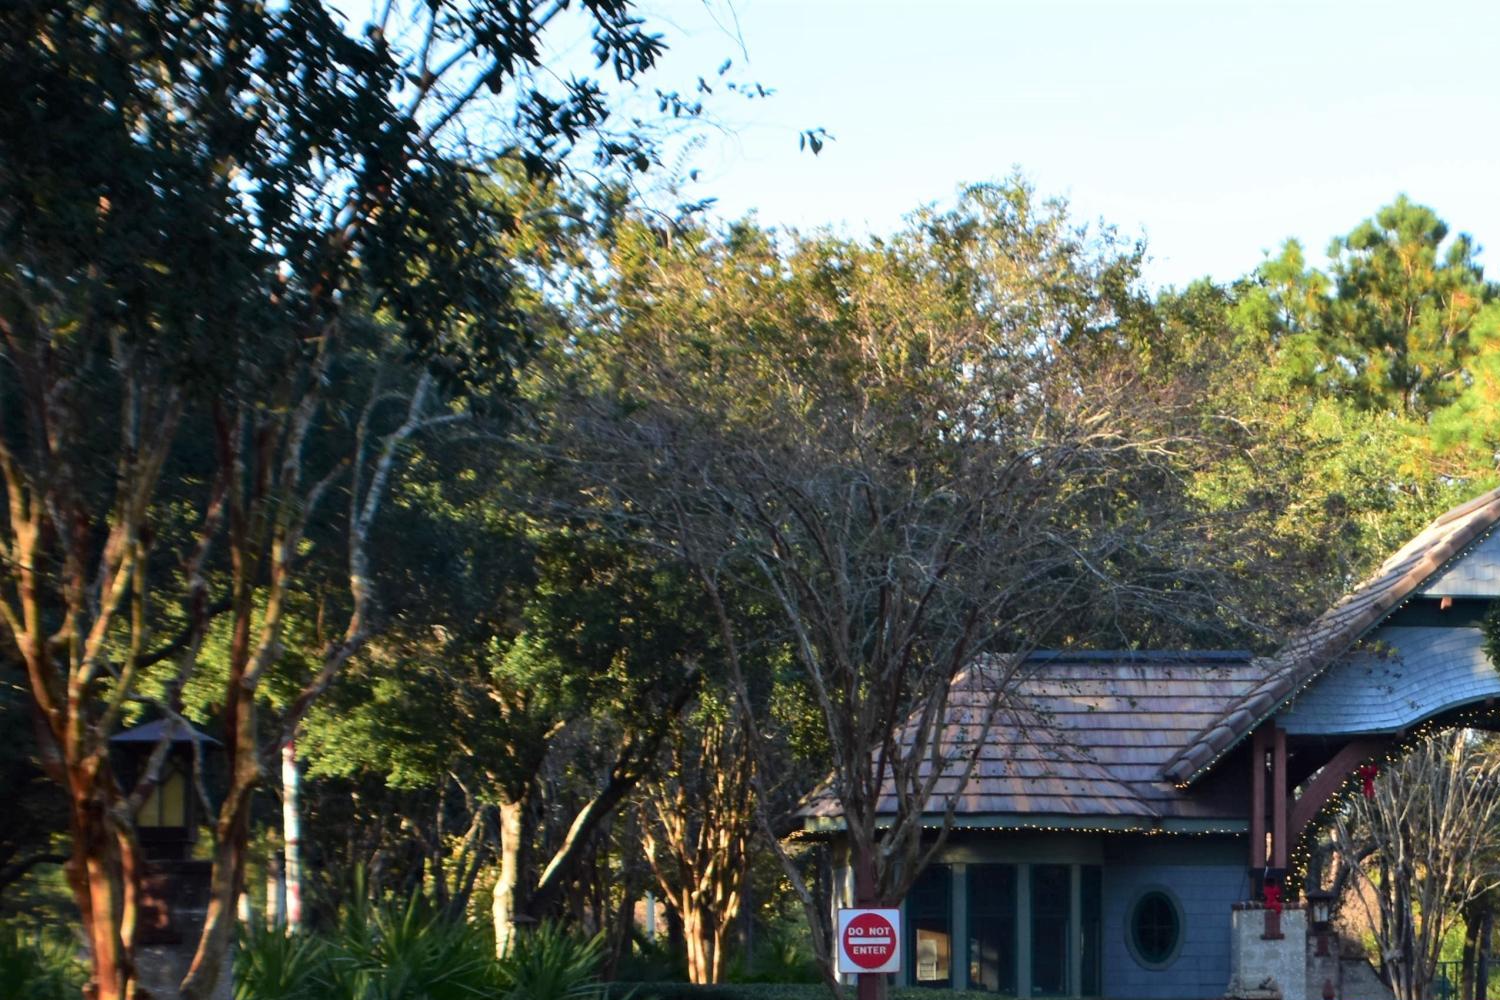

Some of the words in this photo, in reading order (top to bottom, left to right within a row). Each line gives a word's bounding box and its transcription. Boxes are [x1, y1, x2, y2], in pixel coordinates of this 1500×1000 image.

[848, 927, 864, 936] DO
[869, 927, 890, 936] NOT
[853, 946, 886, 954] ENTER
